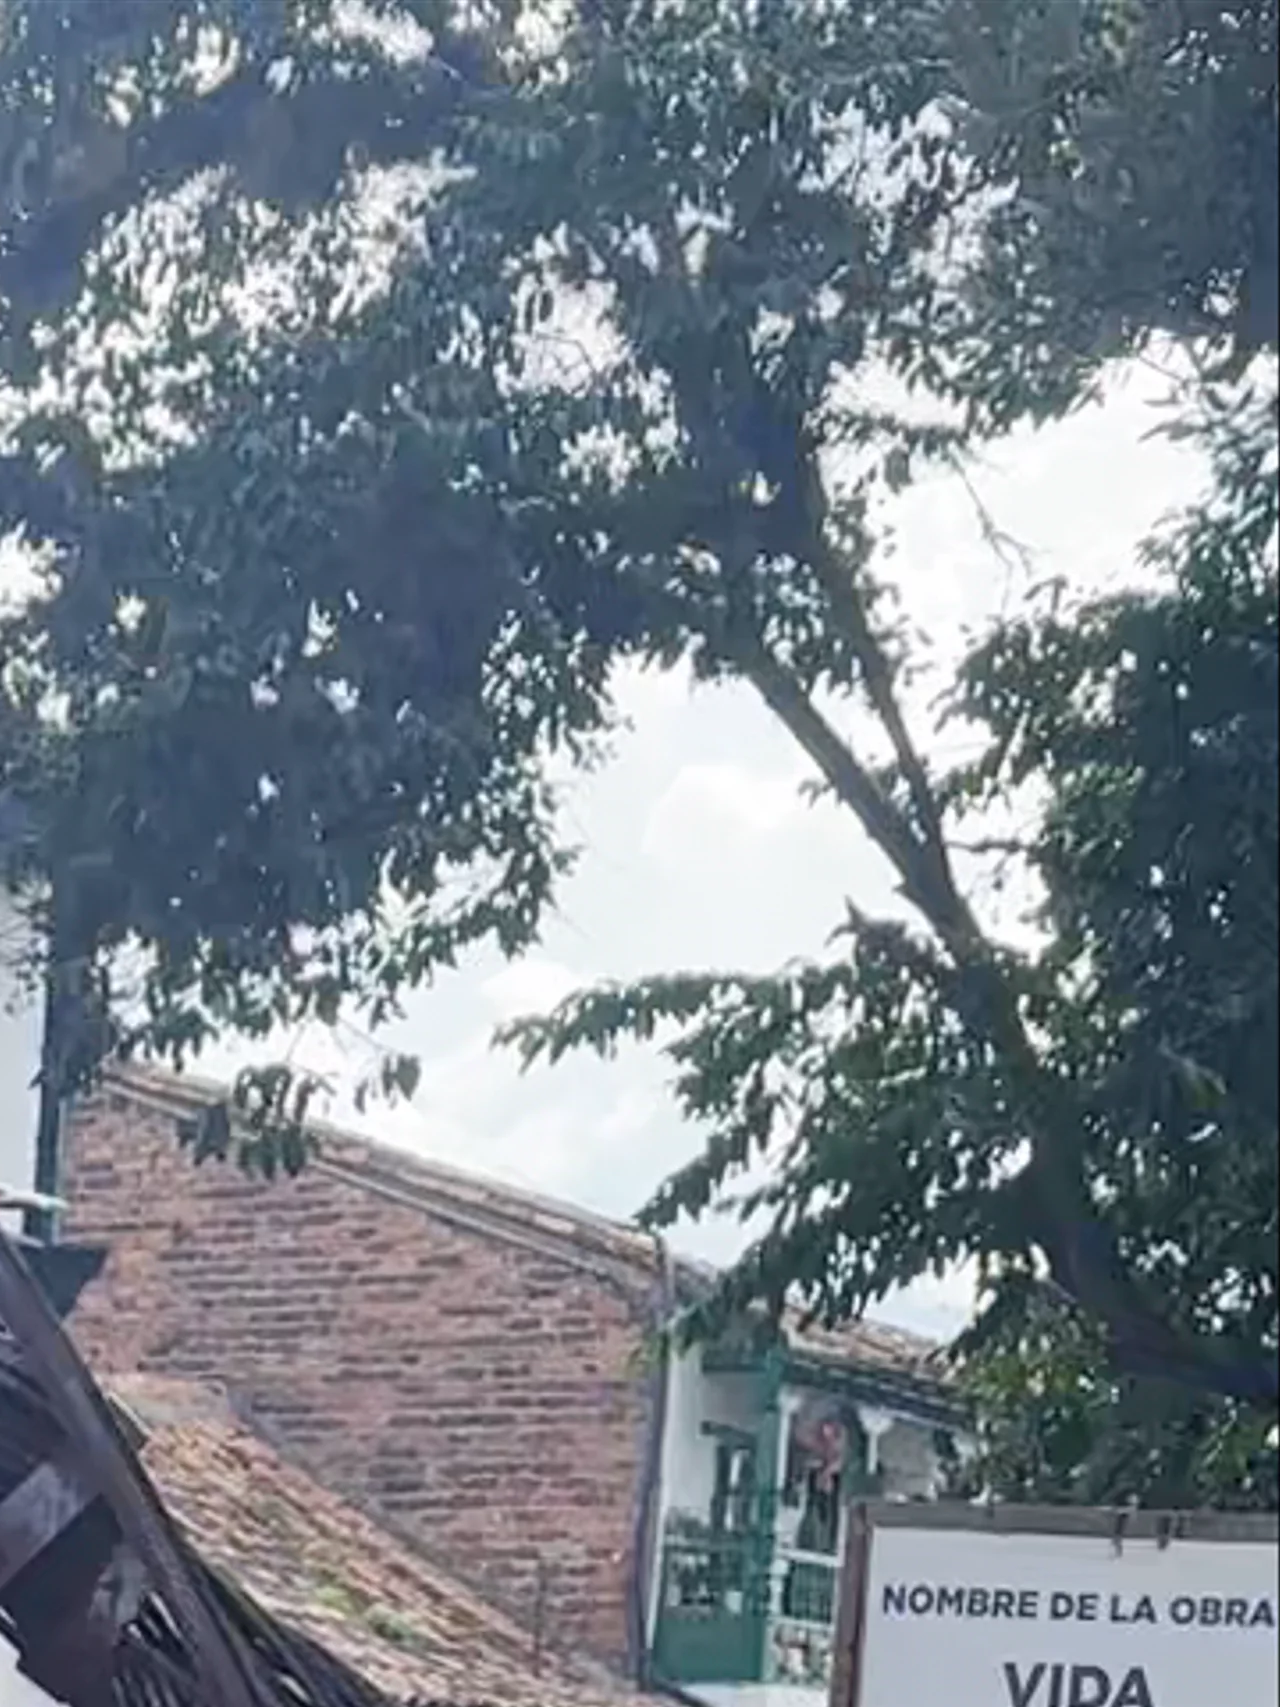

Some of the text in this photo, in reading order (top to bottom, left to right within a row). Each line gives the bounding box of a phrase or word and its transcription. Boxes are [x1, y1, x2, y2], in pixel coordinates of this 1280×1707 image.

[882, 1584, 1275, 1628] NOMBRE DE LA OBRA
